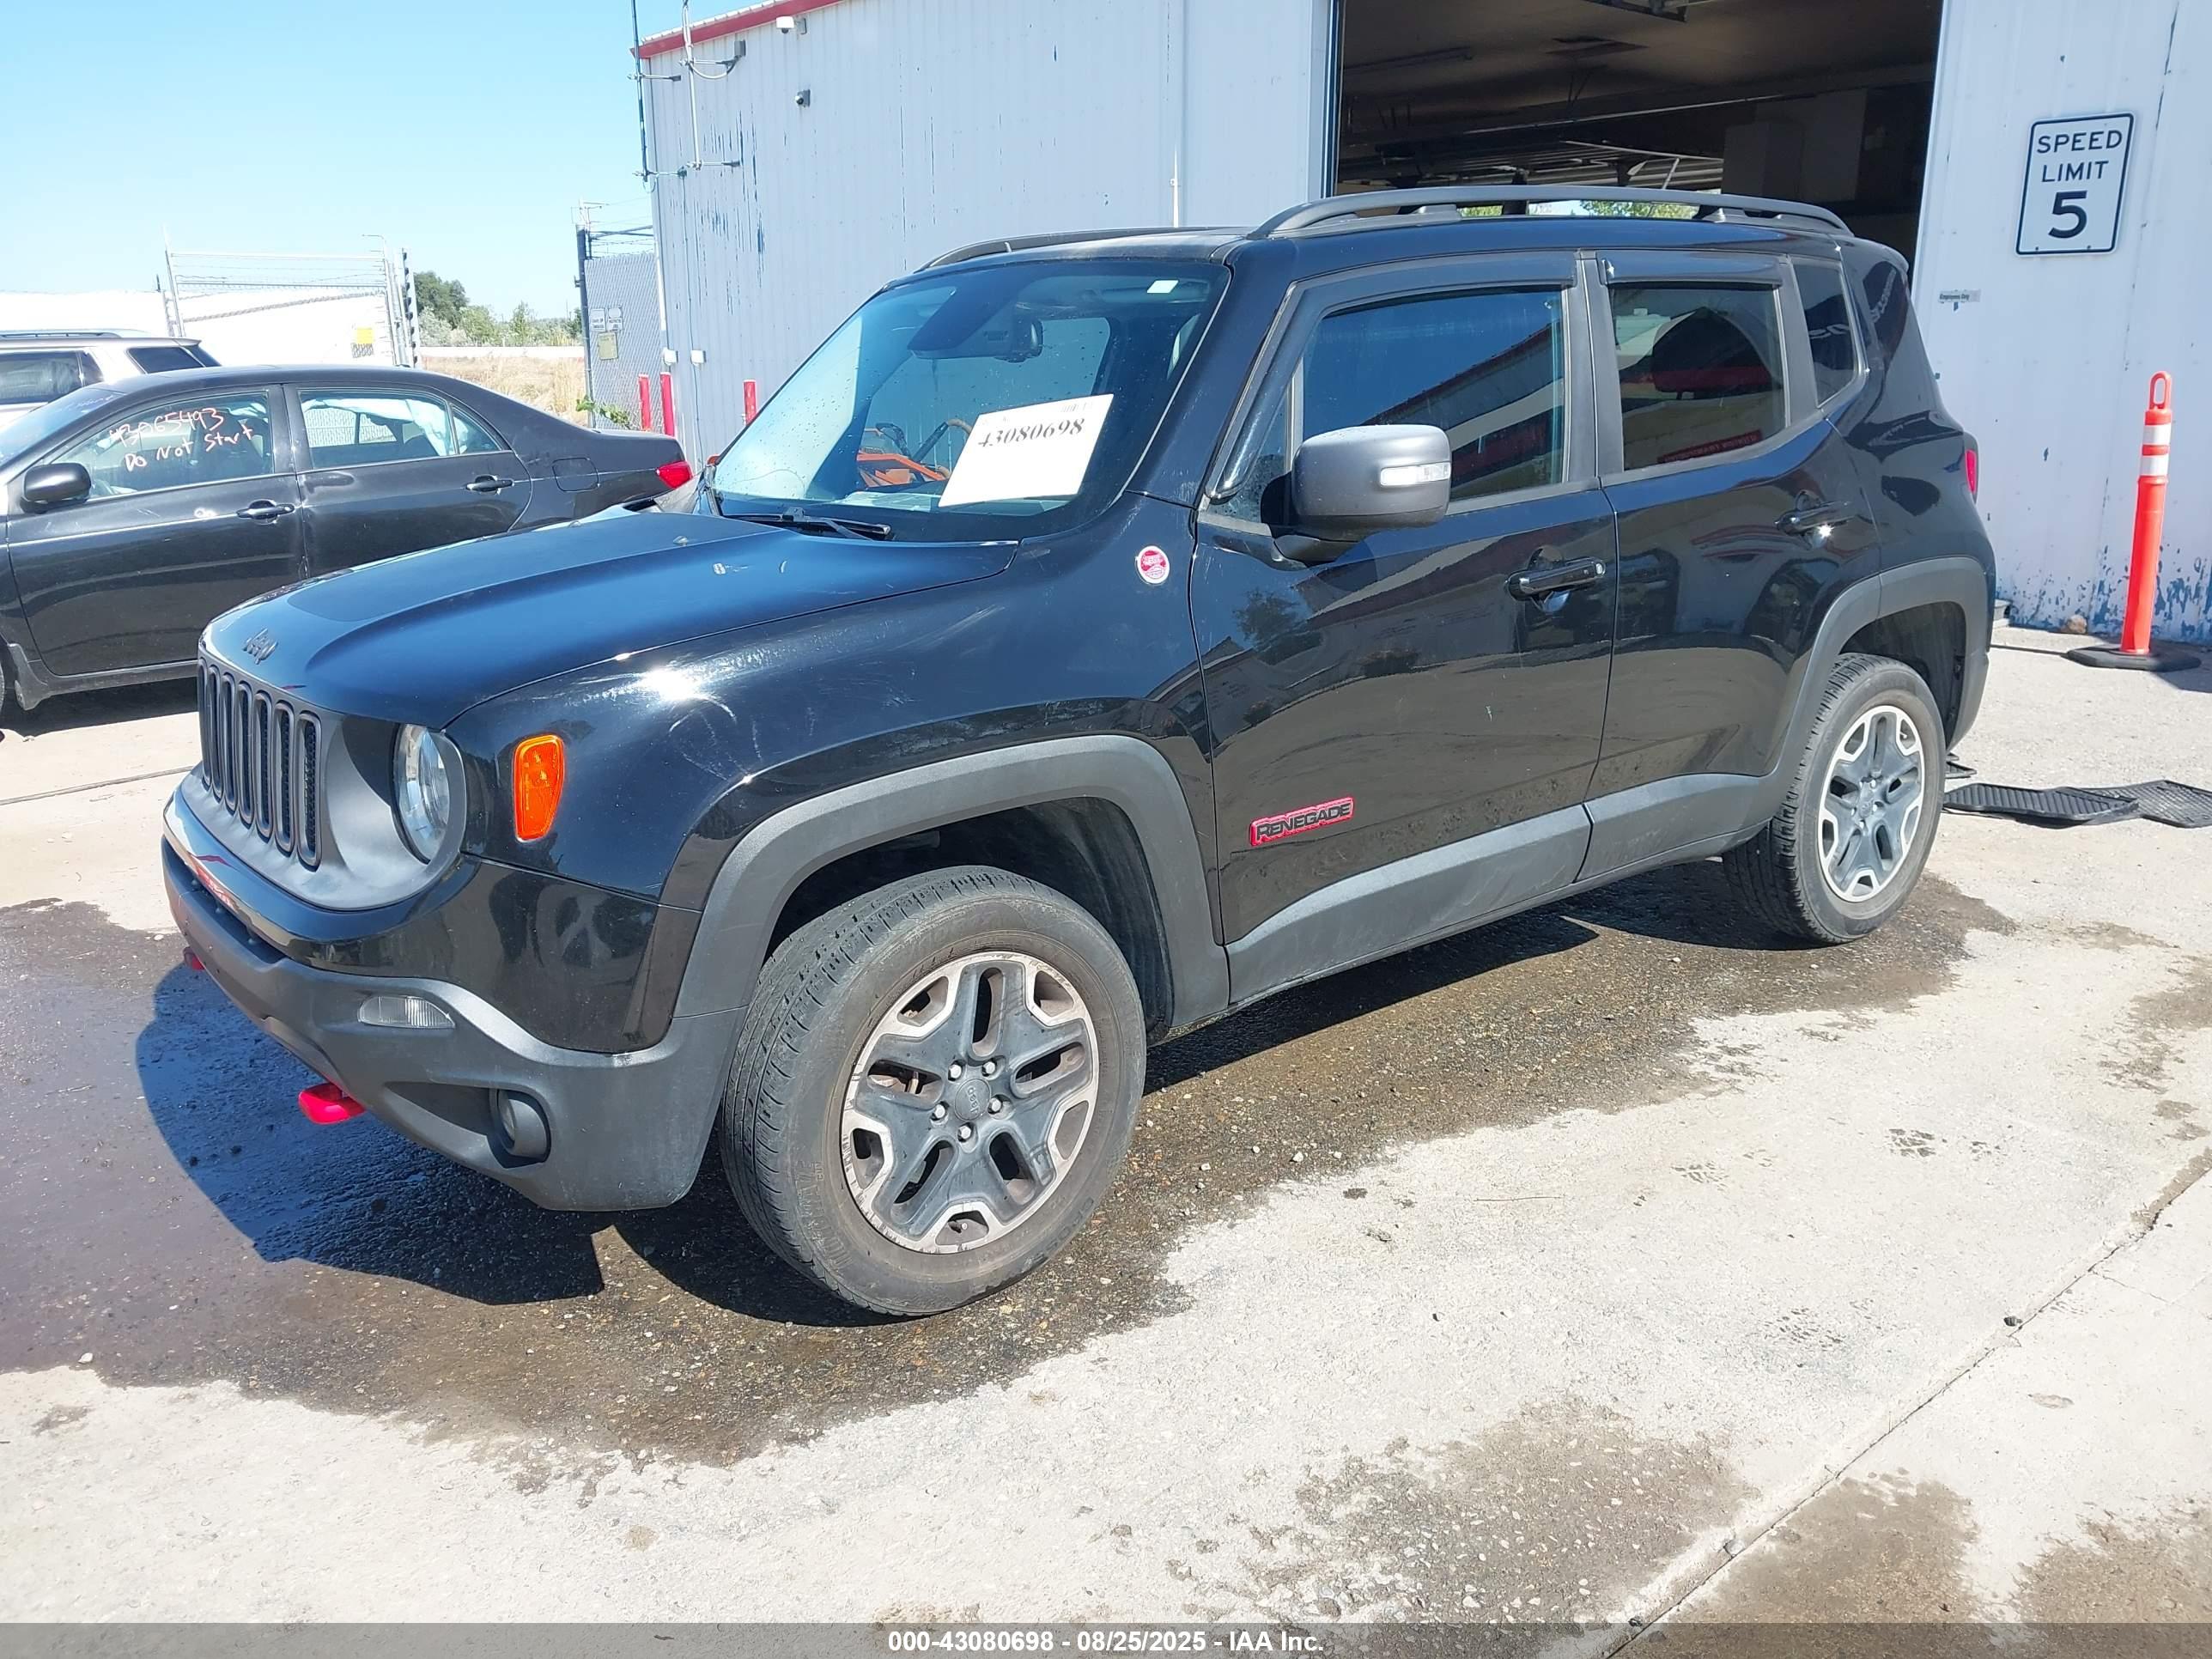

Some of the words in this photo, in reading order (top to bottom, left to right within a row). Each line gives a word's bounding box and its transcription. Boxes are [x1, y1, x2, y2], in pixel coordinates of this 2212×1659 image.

[2037, 130, 2123, 154] SPEED
[2041, 161, 2109, 183] LIMIT
[2048, 190, 2087, 239] 5
[204, 422, 253, 453] Start
[978, 417, 1085, 447] 43080698
[1255, 801, 1352, 842] RENEGADE
